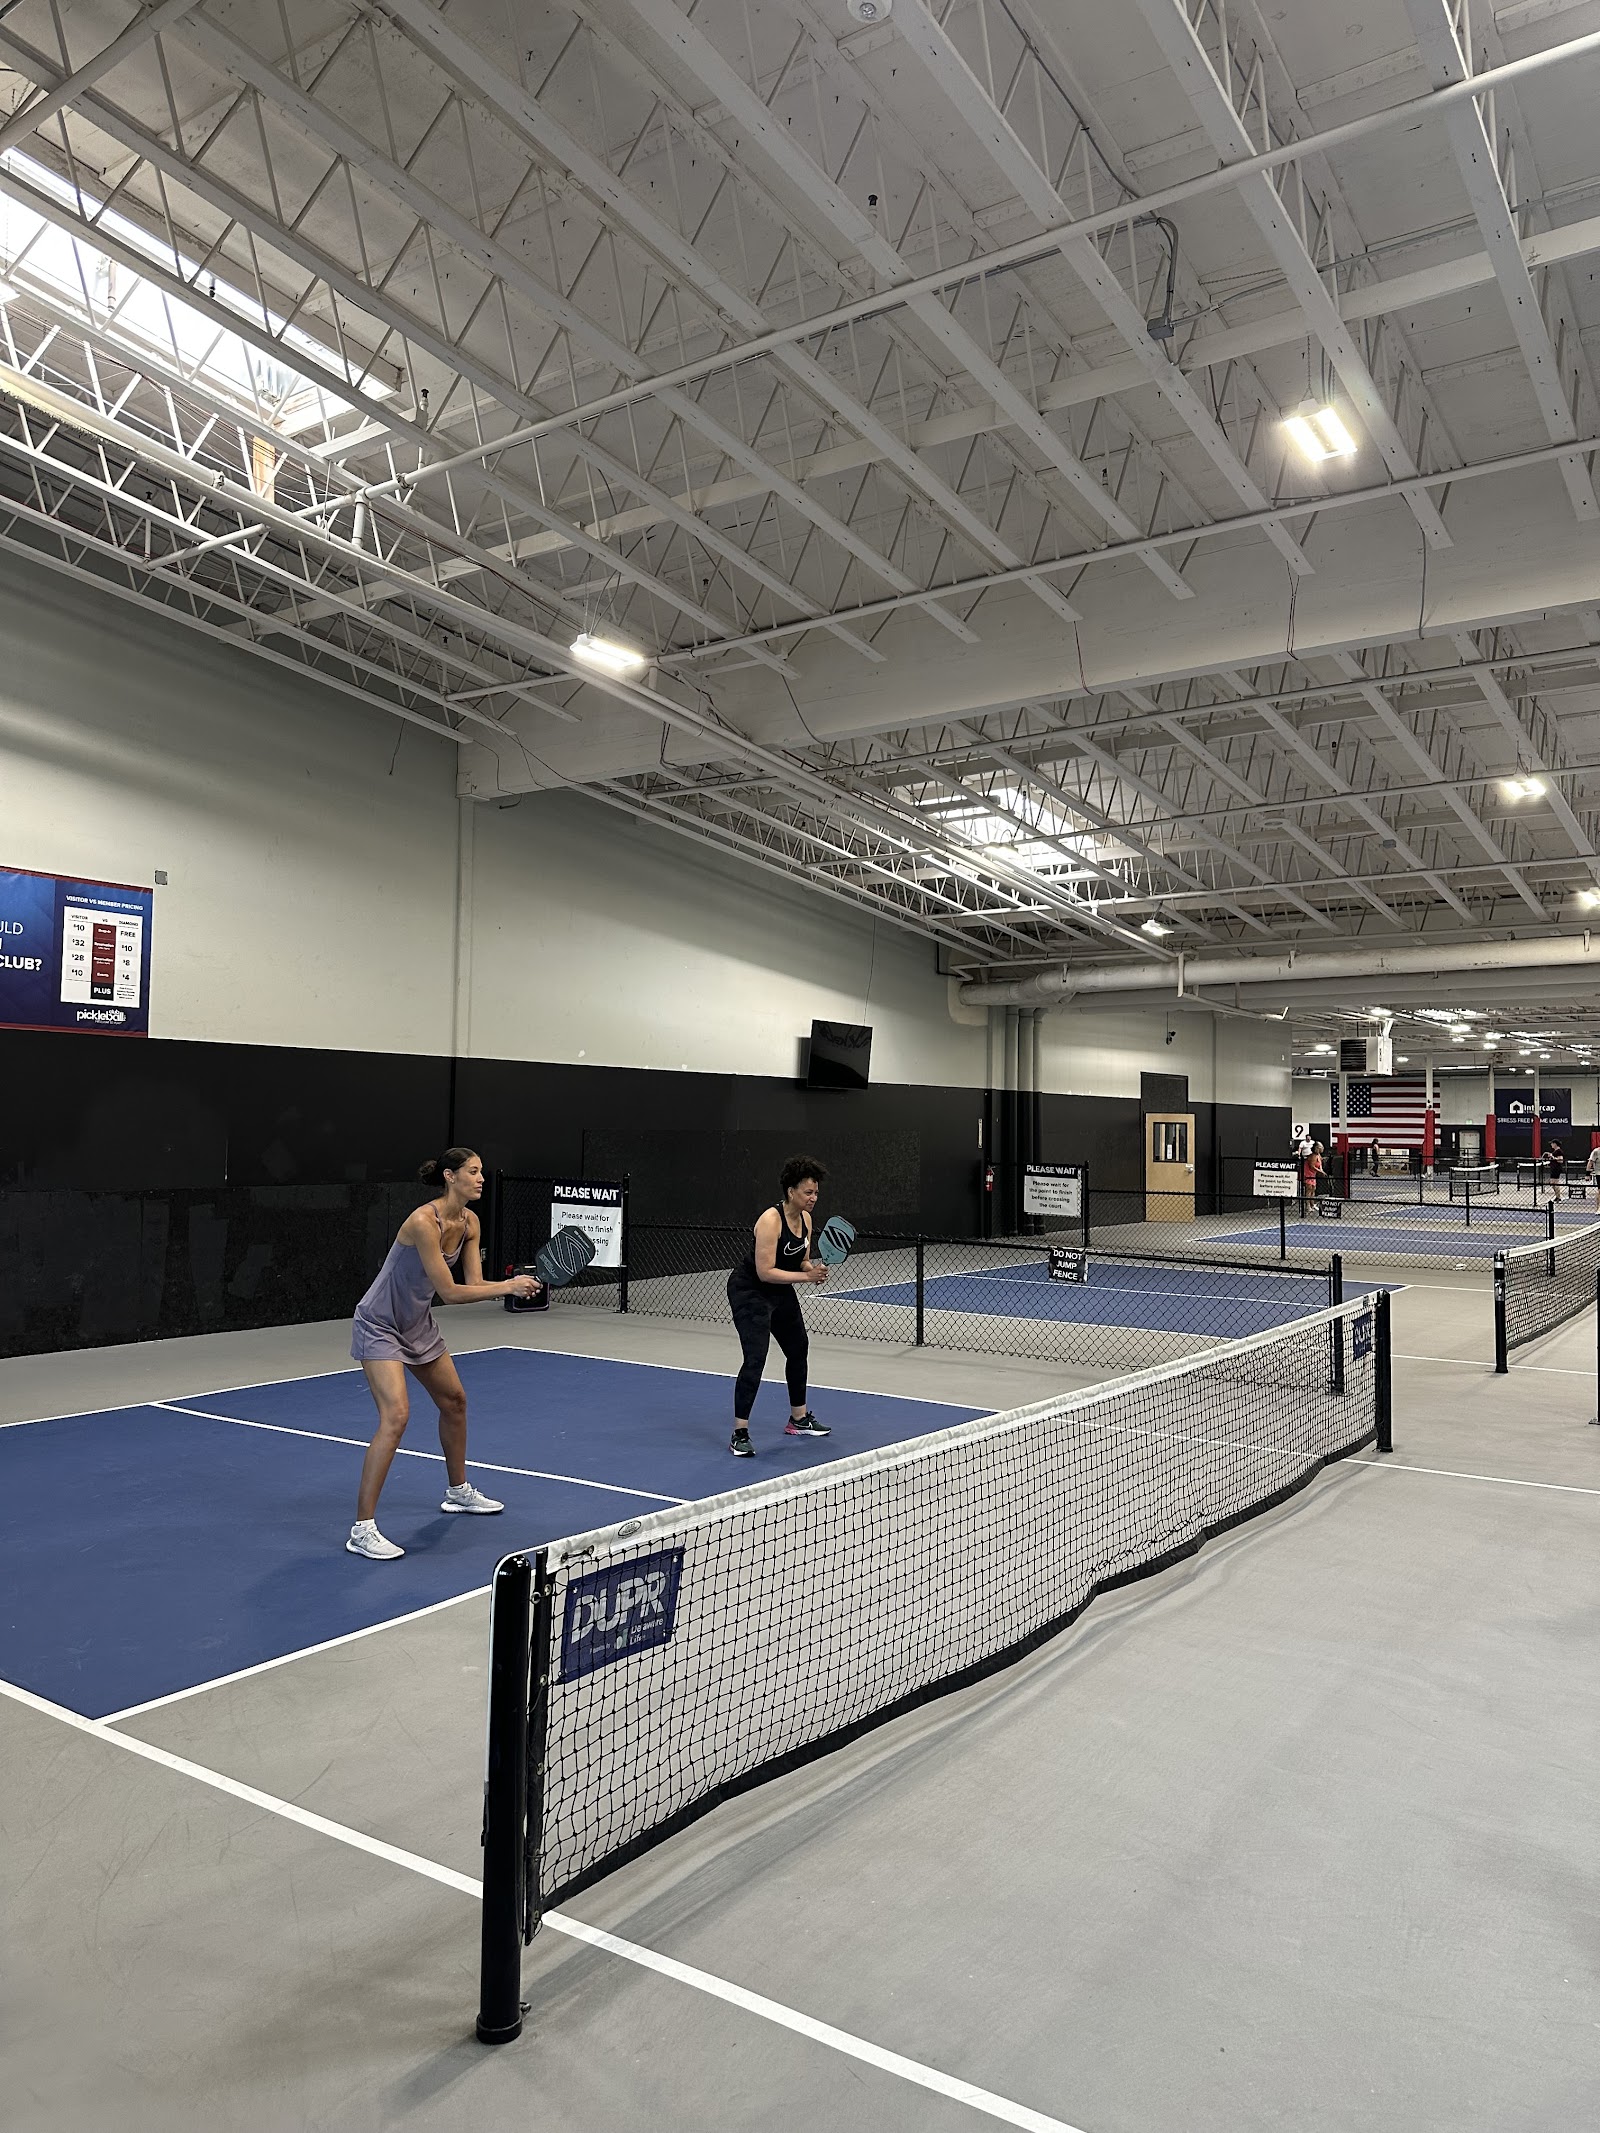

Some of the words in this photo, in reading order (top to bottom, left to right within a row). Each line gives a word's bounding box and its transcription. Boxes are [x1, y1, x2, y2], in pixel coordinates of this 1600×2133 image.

[66, 895, 89, 904] VISITOR
[97, 899, 121, 908] MEMBER
[121, 903, 143, 911] PRICING
[73, 923, 85, 931] $10
[120, 930, 136, 938] FREE
[72, 938, 85, 947] $32
[121, 944, 133, 952] $10
[71, 953, 85, 961] $28
[122, 959, 131, 967] $8
[71, 968, 84, 977] $10
[122, 973, 130, 981] $4
[93, 986, 112, 995] PLUS
[76, 1008, 125, 1022] pickleball
[1524, 1104, 1556, 1113] Intrcap
[1295, 1124, 1304, 1138] 9
[1026, 1164, 1055, 1174] PLEASE
[1055, 1166, 1076, 1175] WAIT
[1255, 1161, 1279, 1169] PLEASE
[554, 1185, 590, 1199] PLEASE
[591, 1187, 619, 1201] WAIT
[561, 1211, 583, 1220] Please
[584, 1213, 599, 1221] wait
[595, 1225, 613, 1233] finish
[1053, 1249, 1064, 1258] DO
[1065, 1251, 1082, 1260] NOT
[1056, 1260, 1077, 1269] JUMP
[1053, 1269, 1078, 1280] FENCE
[571, 1570, 667, 1644] DUPR
